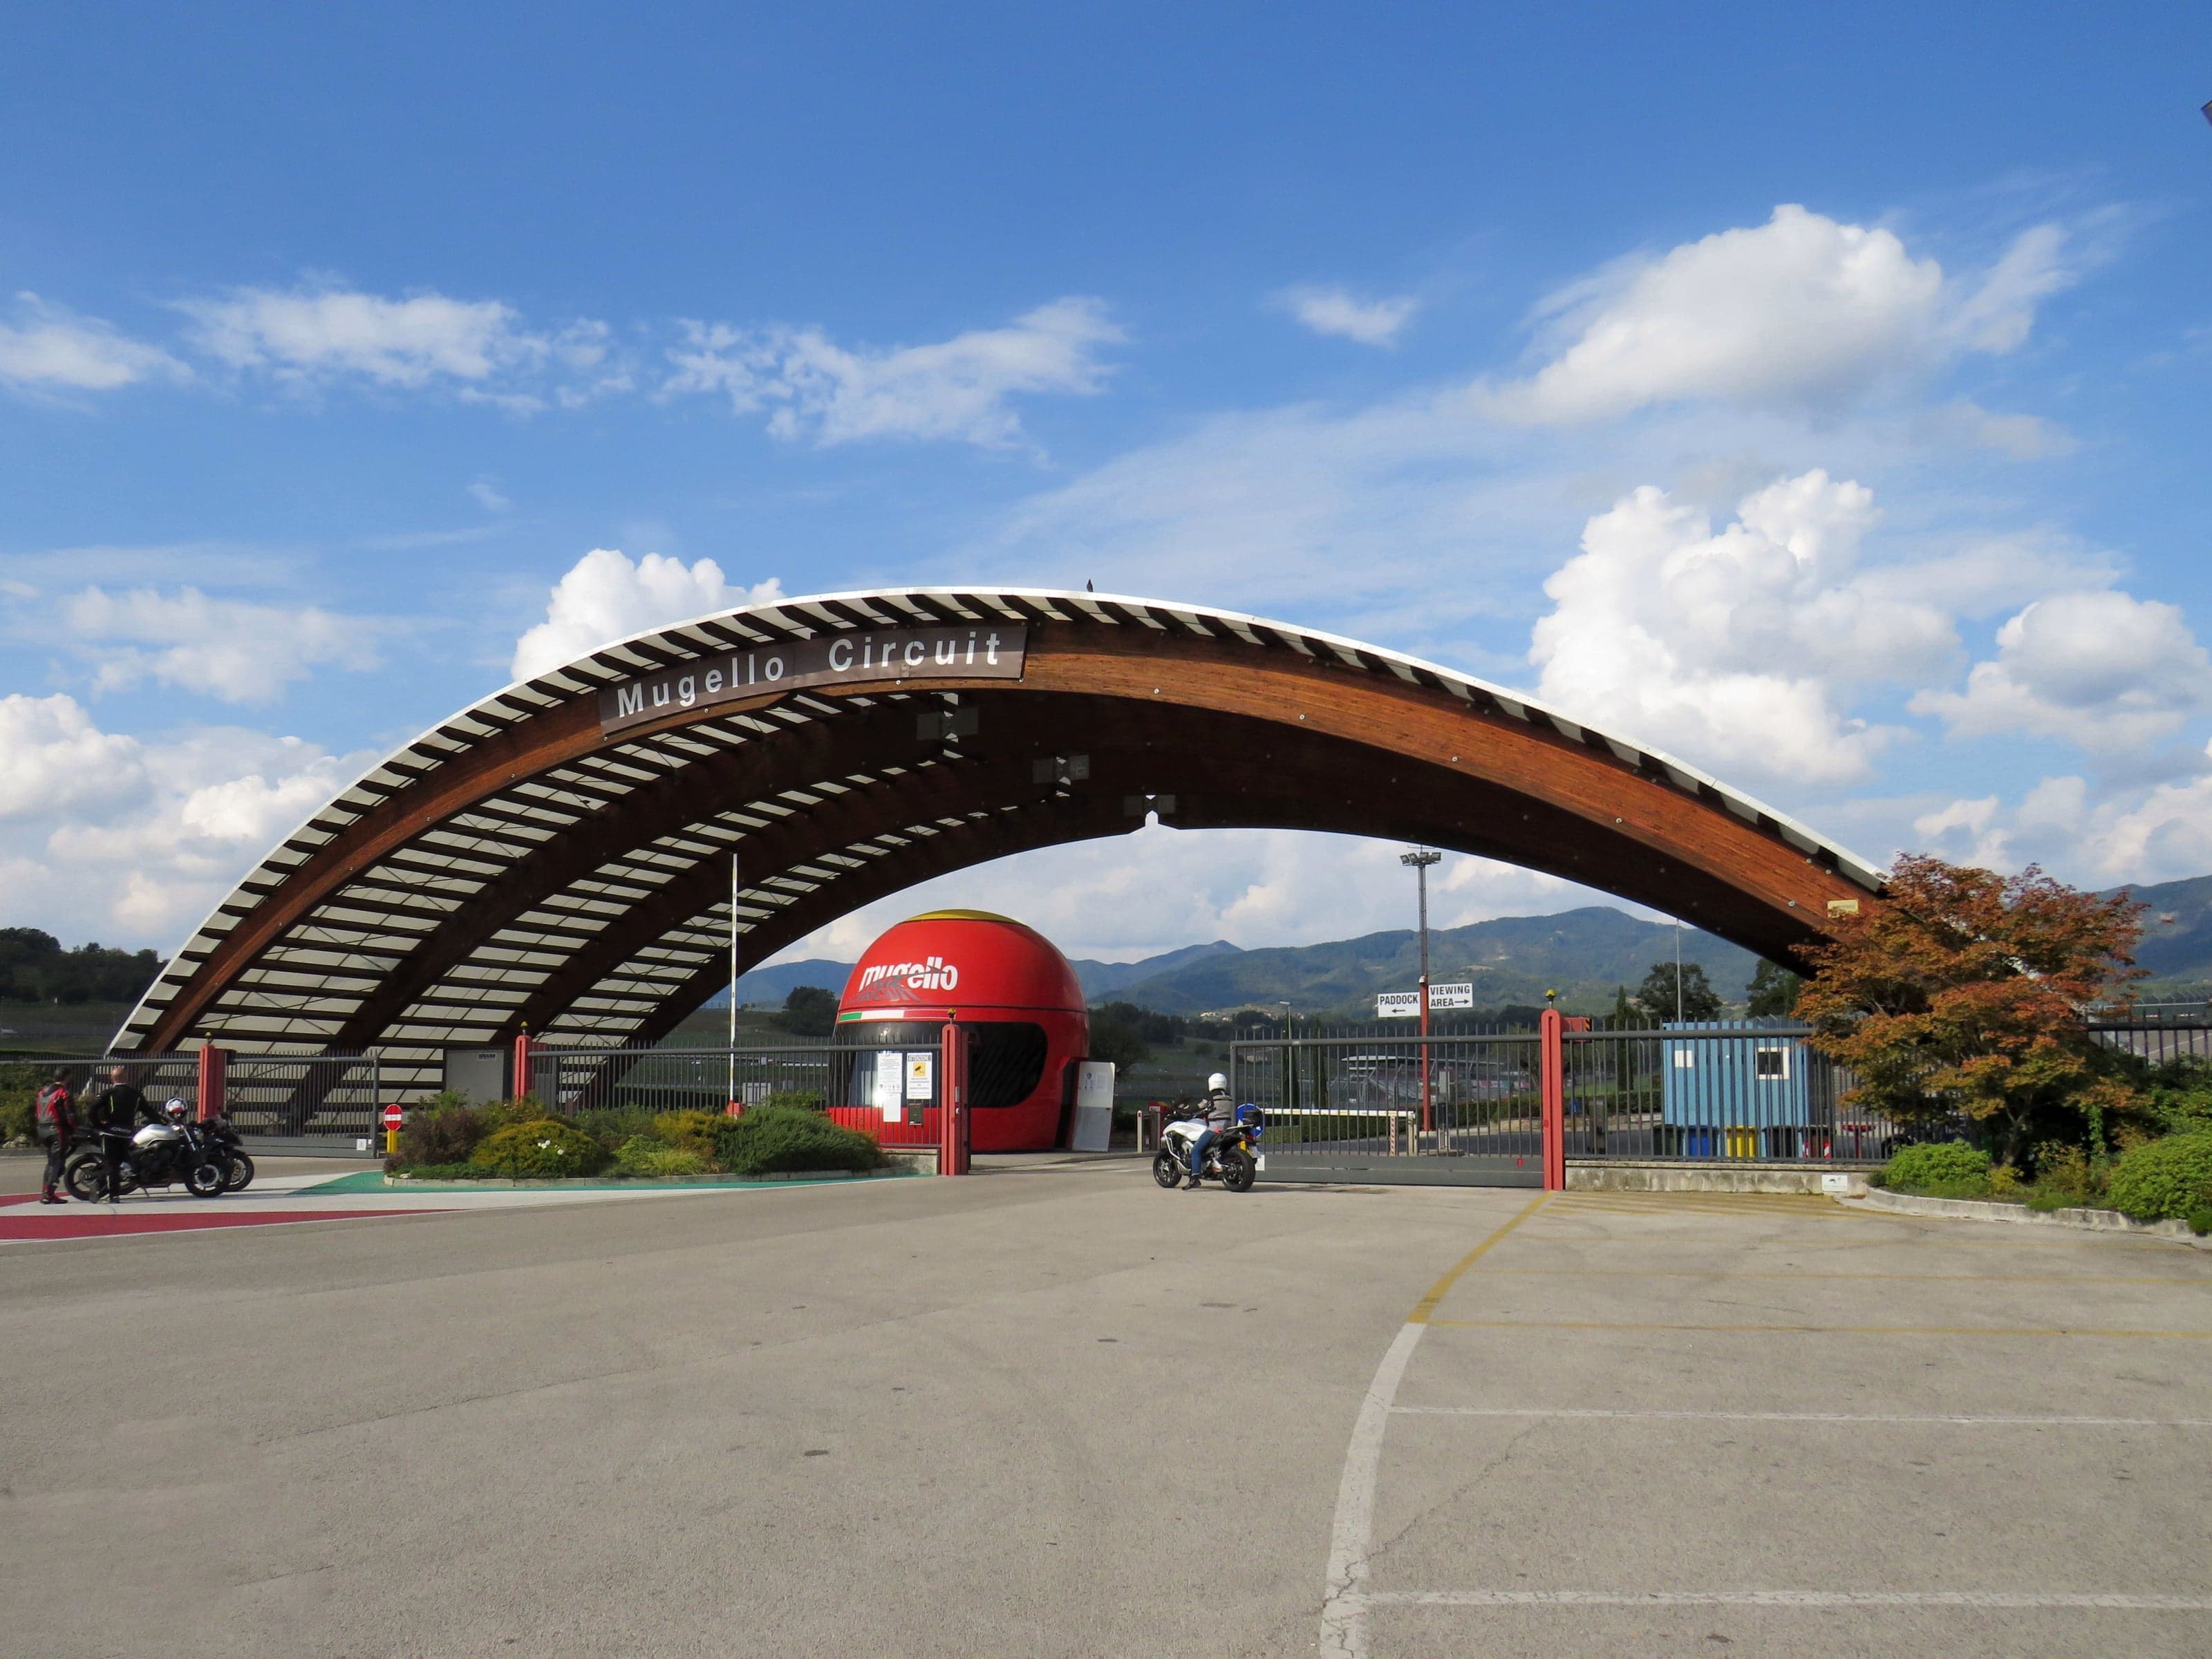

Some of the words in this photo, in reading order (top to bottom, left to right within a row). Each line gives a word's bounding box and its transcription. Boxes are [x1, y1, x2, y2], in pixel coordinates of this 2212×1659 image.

[617, 656, 785, 718] Mugello
[828, 631, 1001, 672] Circuit
[858, 956, 959, 993] mugello
[1430, 985, 1470, 995] VIEWING
[1380, 994, 1418, 1005] PADDOCK
[1430, 998, 1454, 1007] AREA
